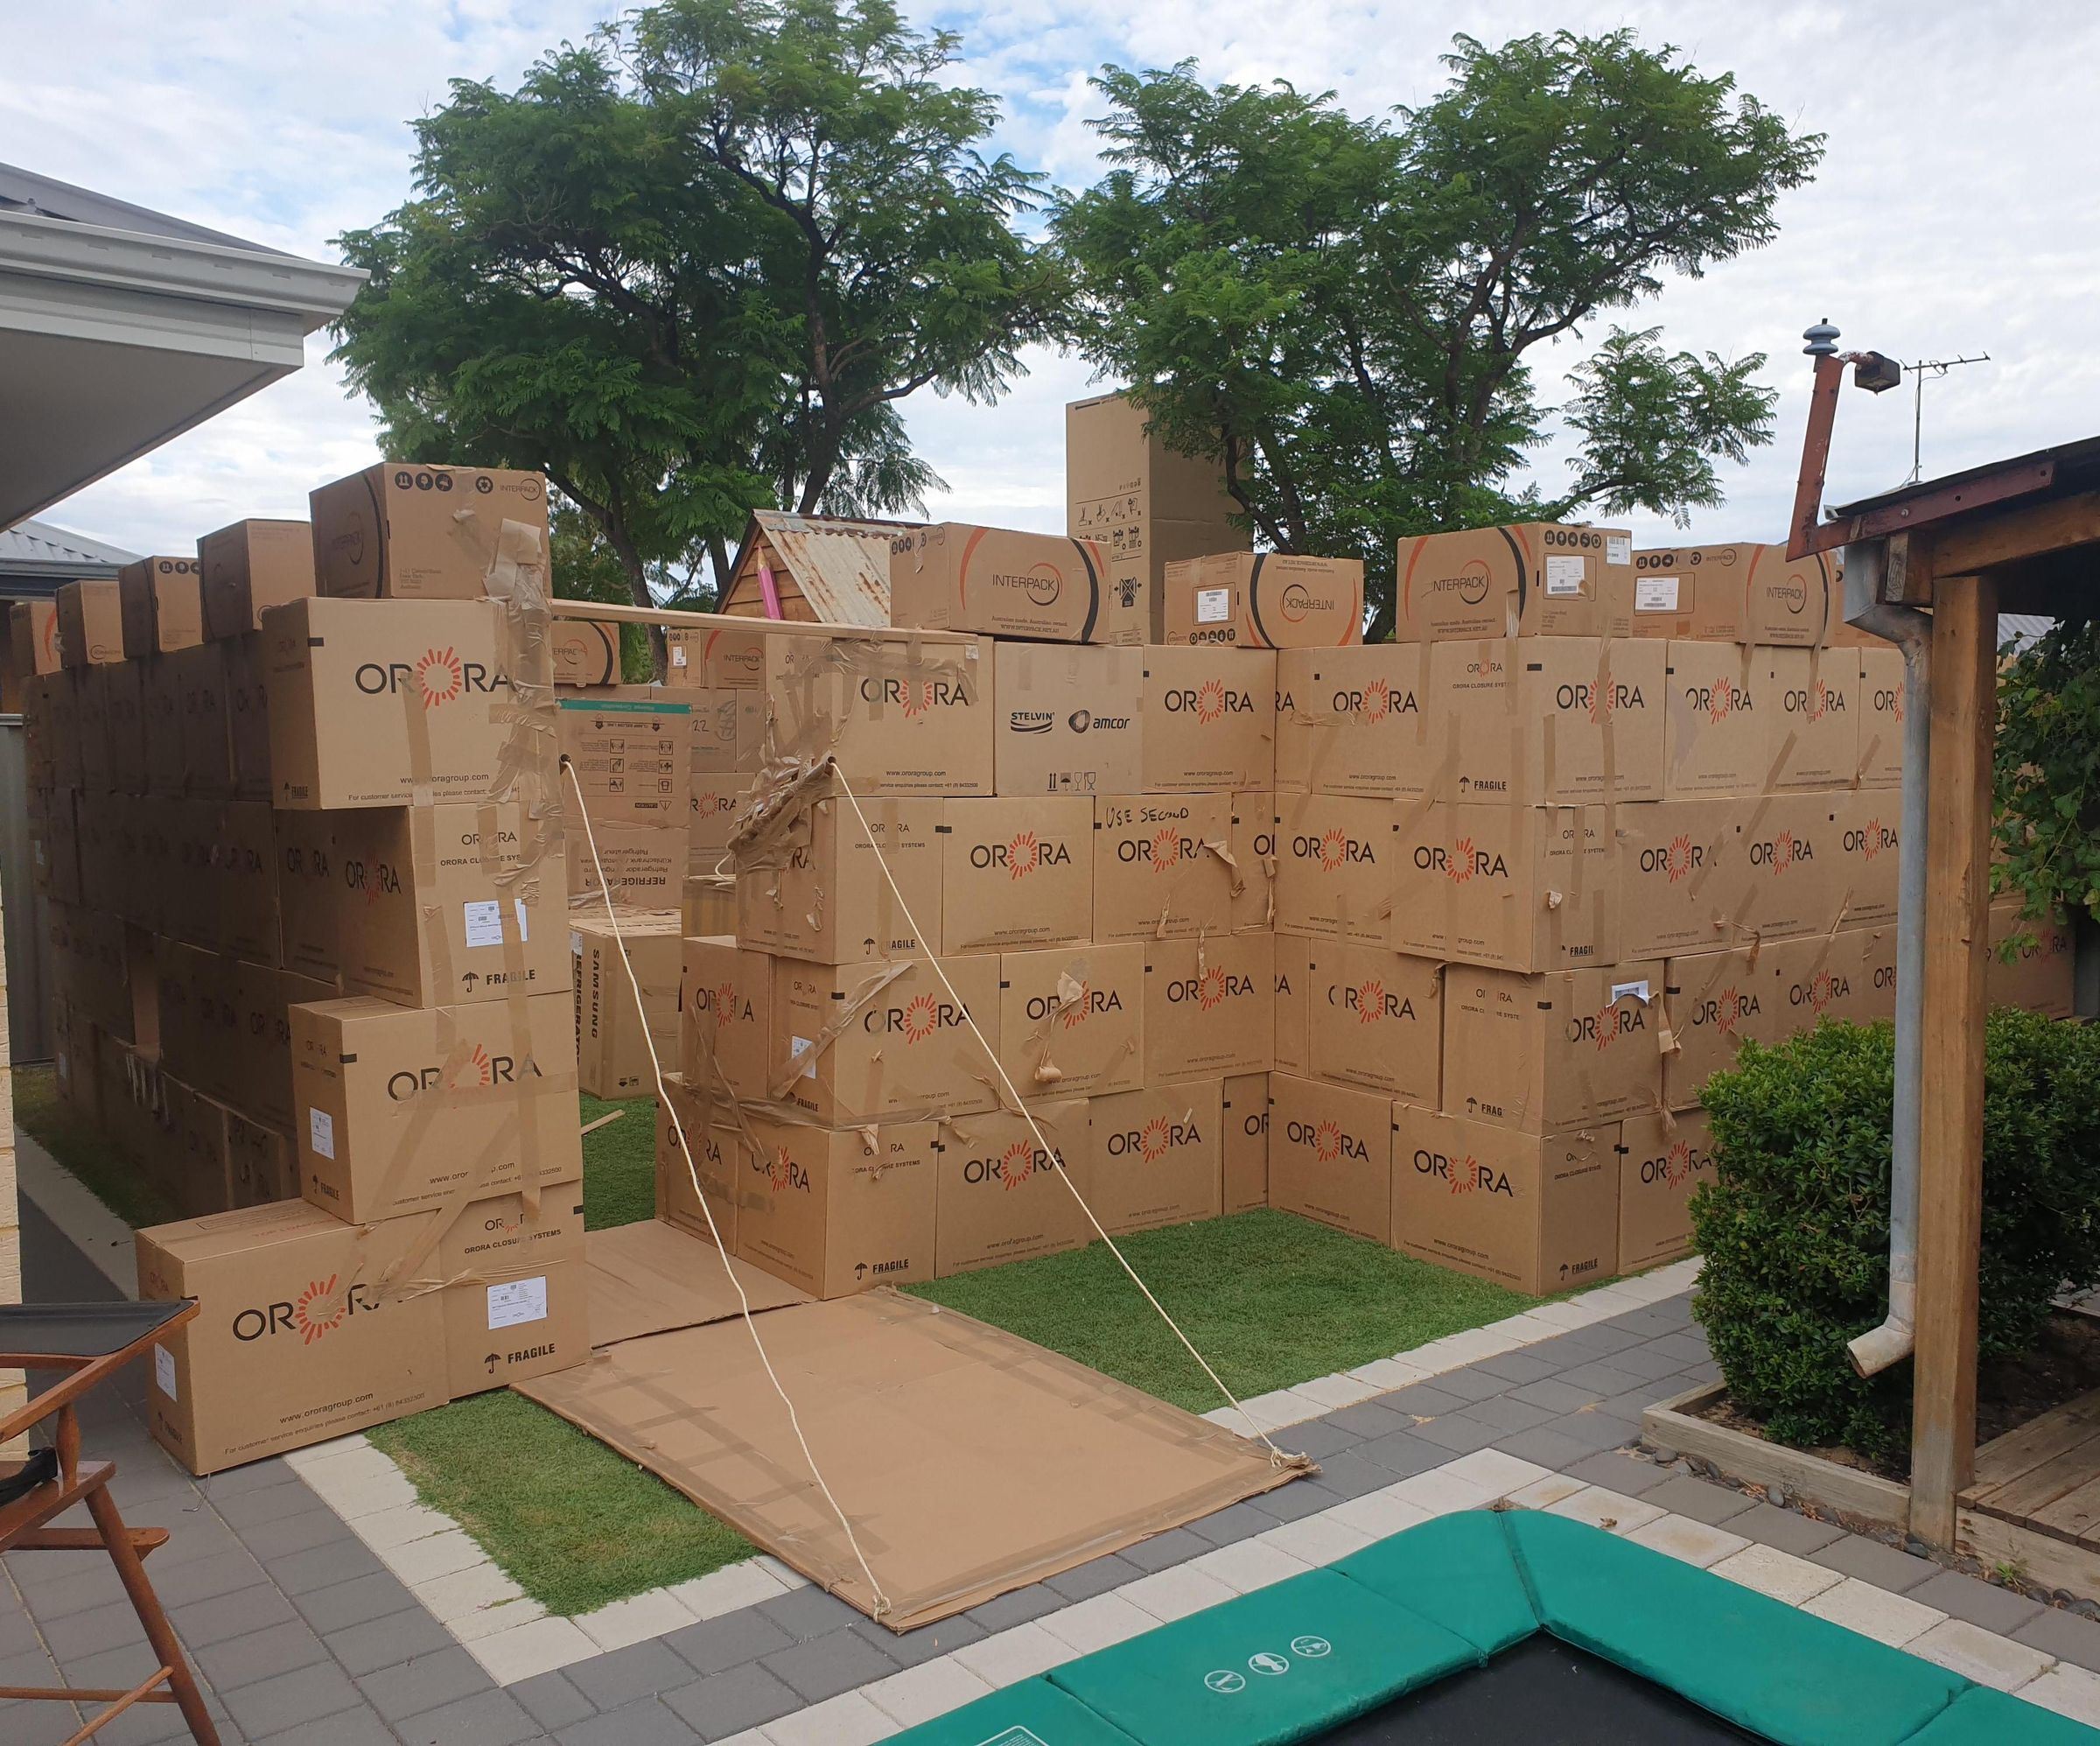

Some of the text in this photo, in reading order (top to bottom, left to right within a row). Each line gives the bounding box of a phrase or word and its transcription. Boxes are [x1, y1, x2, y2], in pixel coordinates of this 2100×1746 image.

[993, 573, 1055, 591] INTERPACK
[1766, 587, 1804, 600] INTERPACK
[1285, 597, 1334, 610] INTERPACK
[1164, 678, 1255, 726] ORORA
[1333, 677, 1418, 725] ORORA
[1685, 677, 1753, 726] ORORA
[1093, 717, 1130, 729] amcor
[1474, 780, 1507, 792] FRAGILE
[871, 823, 910, 833] ORRA
[1106, 807, 1132, 828] USE
[461, 831, 517, 846] ORRA
[1563, 829, 1595, 839] ORRA
[1843, 817, 1899, 861] ORORA
[440, 859, 468, 867] ORORA
[970, 831, 1072, 880] ORORA
[1292, 828, 1376, 873] ORORA
[1414, 837, 1508, 884] ORORA
[1750, 829, 1813, 876] ORORA
[592, 948, 600, 1039] SAMSUNG
[1167, 965, 1255, 1011] ORORA
[1789, 968, 1851, 1014] ORORA
[796, 1097, 819, 1113] FRAGILE
[1107, 1116, 1201, 1164] ORORA
[1287, 1119, 1369, 1163] ORORA
[895, 1160, 921, 1169] SYSTEMS
[963, 1139, 1067, 1190] ORORA
[1413, 1149, 1514, 1197] ORORA
[464, 1243, 491, 1254] ORORA
[872, 1259, 909, 1274] FRAGILE
[1572, 1258, 1599, 1275] FRAGILE
[507, 1342, 556, 1364] FRAGILE
[279, 1392, 374, 1424] www.ororagroup.com
[225, 1446, 237, 1455] For
[270, 1431, 293, 1441] service
[295, 1422, 324, 1436] enquiries
[325, 1416, 346, 1427] please
